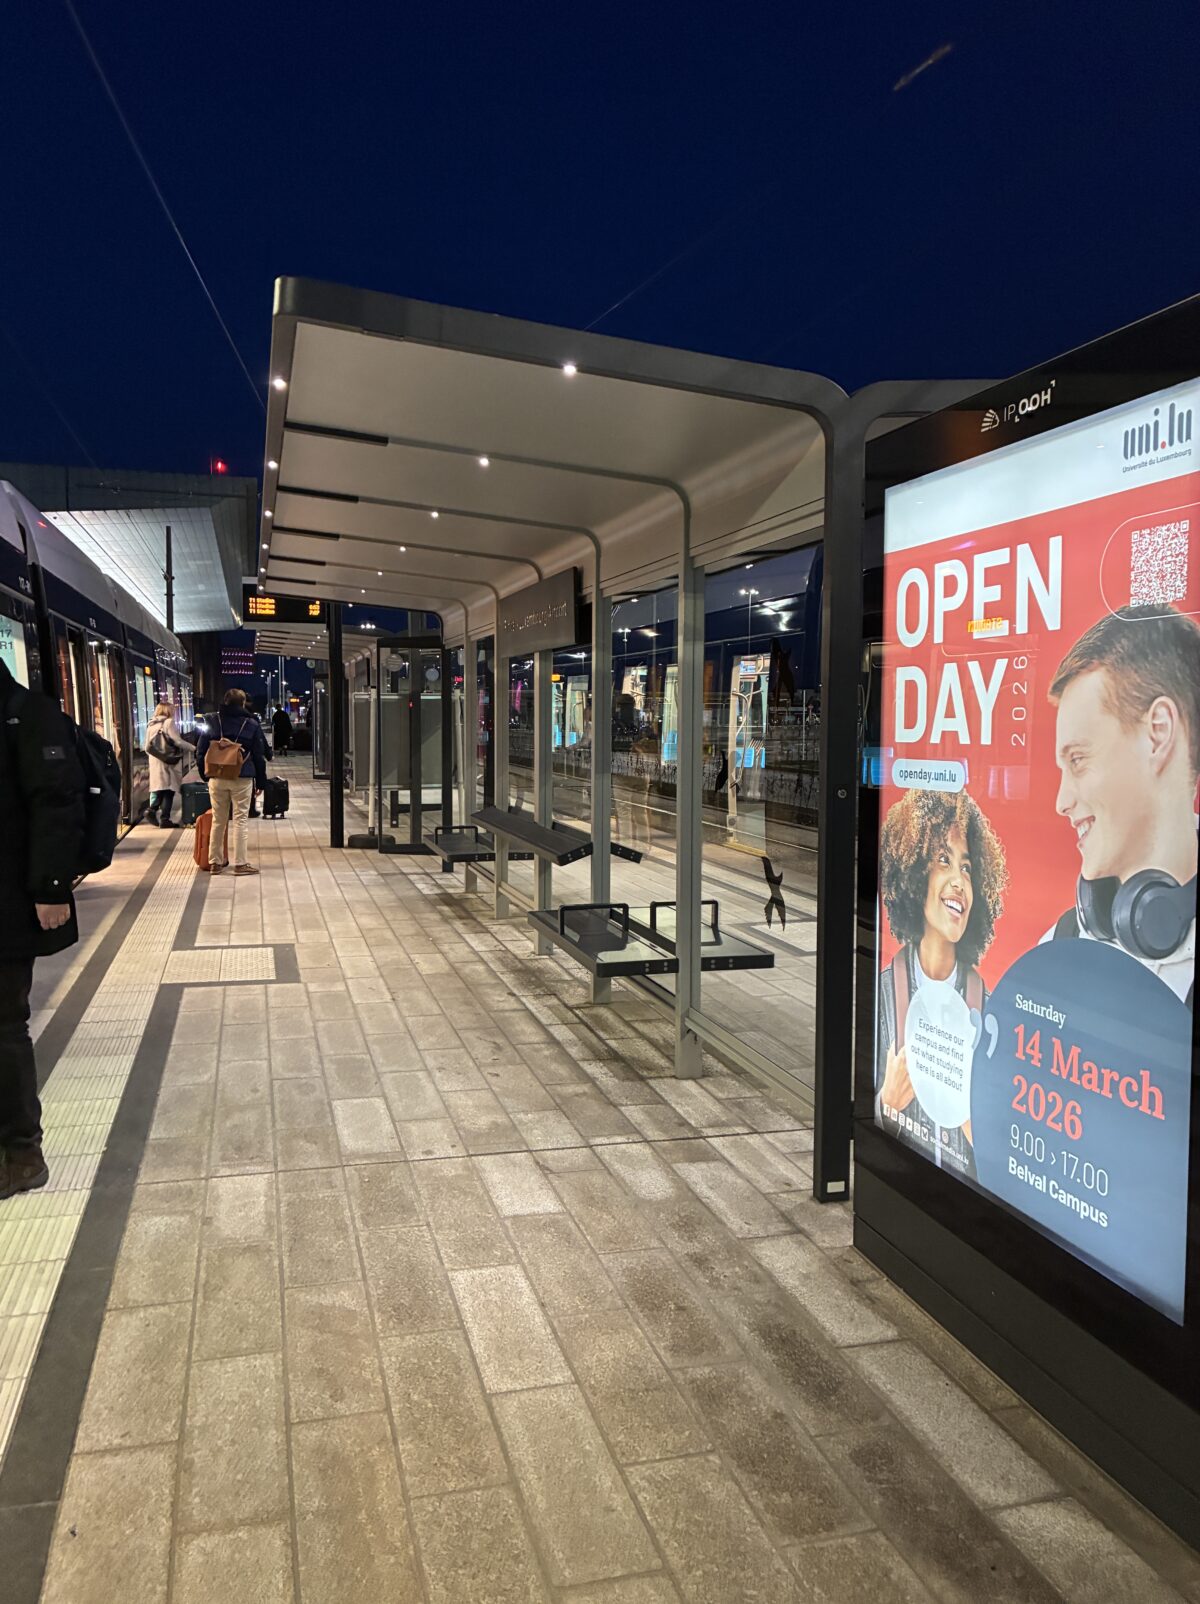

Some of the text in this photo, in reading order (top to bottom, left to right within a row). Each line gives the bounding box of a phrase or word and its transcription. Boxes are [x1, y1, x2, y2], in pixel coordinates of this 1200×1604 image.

[1123, 402, 1192, 460] uni.lu
[1148, 458, 1156, 466] du
[1156, 449, 1192, 463] Luxembourg
[896, 535, 1063, 648] OPEN
[895, 658, 1009, 746] DAY
[1011, 655, 1028, 747] 2026
[898, 768, 957, 783] openday.uni.lu
[918, 1018, 964, 1046] Experience our
[1015, 993, 1067, 1030] Saturday
[910, 1044, 964, 1079] out what studying
[914, 1033, 964, 1062] campus and find
[916, 1059, 929, 1074] here
[936, 1071, 944, 1082] all
[944, 1075, 963, 1092] about
[1013, 1023, 1166, 1121] 14 March
[1011, 1074, 1084, 1141] 2026
[1010, 1123, 1109, 1197] 9.00 17.00
[1008, 1156, 1109, 1228] Belval Campus
